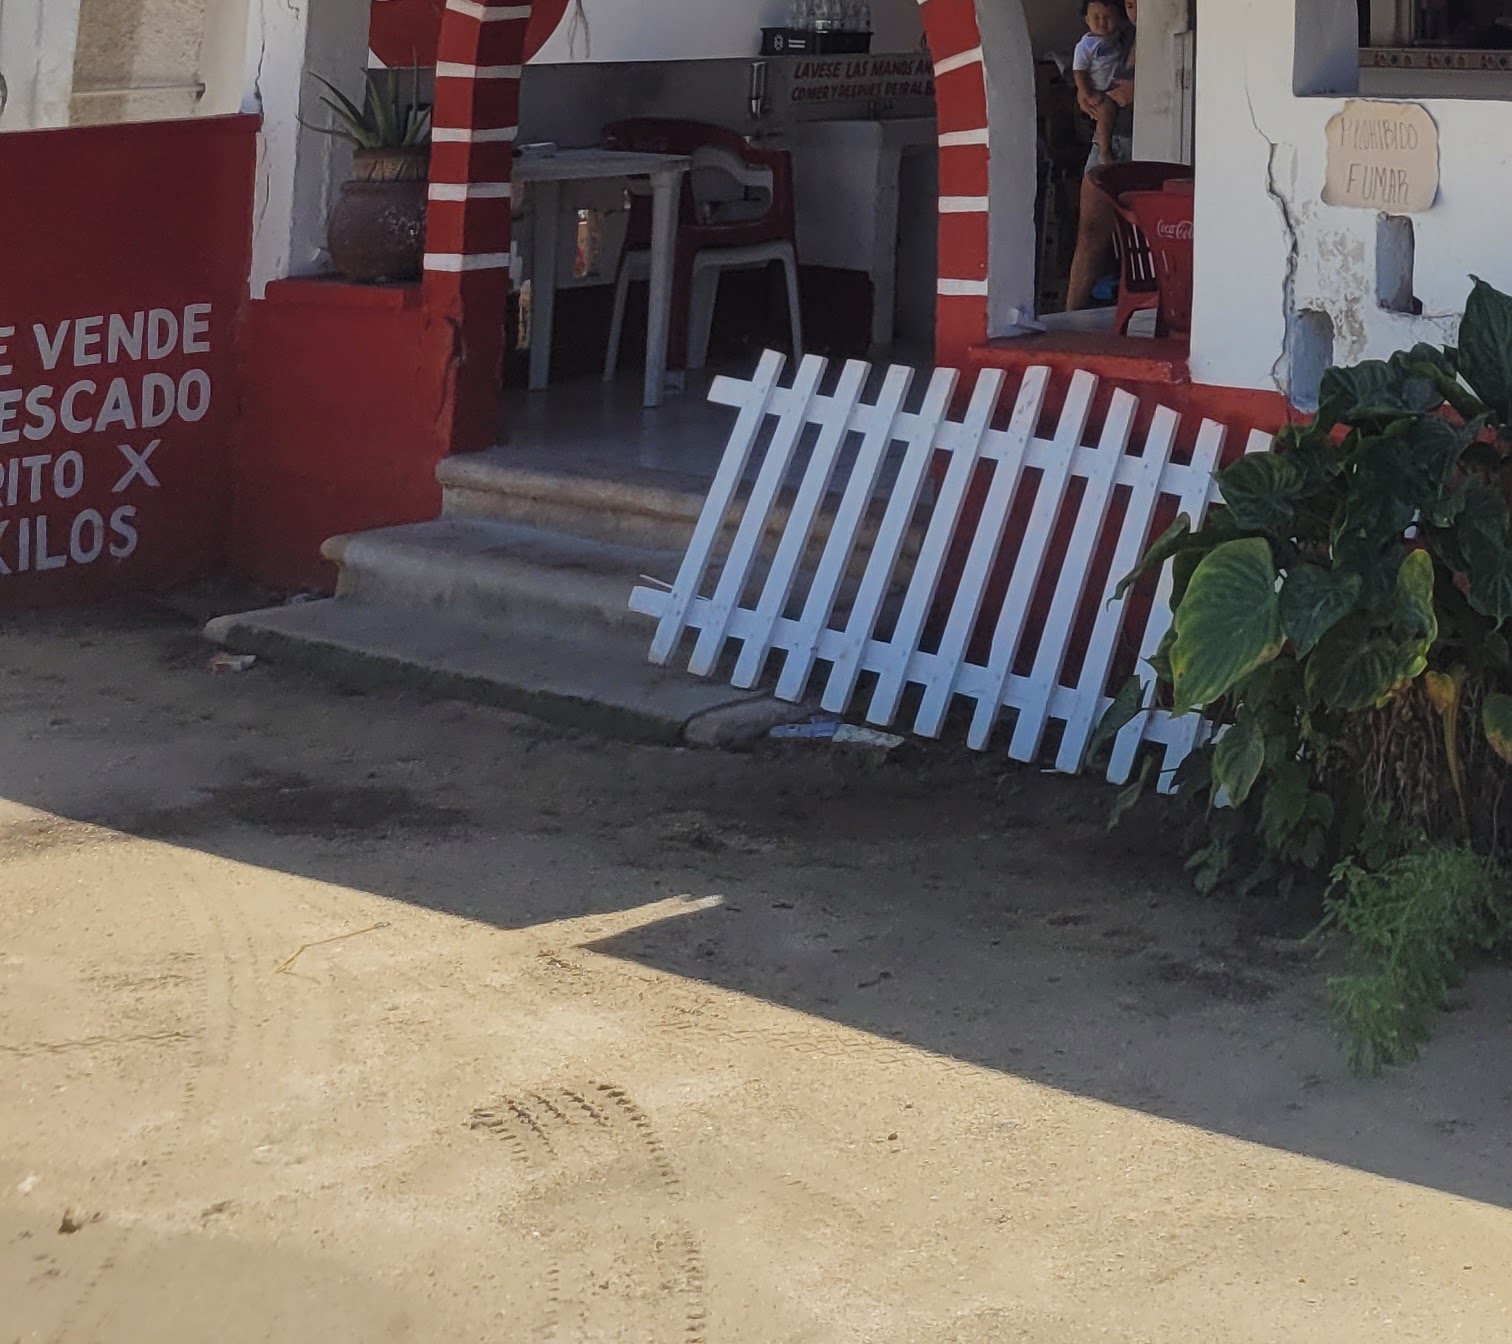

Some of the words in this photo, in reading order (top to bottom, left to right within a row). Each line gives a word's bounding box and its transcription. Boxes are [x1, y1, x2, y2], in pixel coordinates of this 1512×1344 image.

[794, 62, 841, 79] LAVESE
[845, 61, 868, 78] LAS
[870, 60, 914, 77] MANOS
[792, 85, 829, 101] COMER
[1346, 163, 1408, 206] FUMAR
[33, 303, 212, 371] VENDE
[111, 439, 162, 493] X
